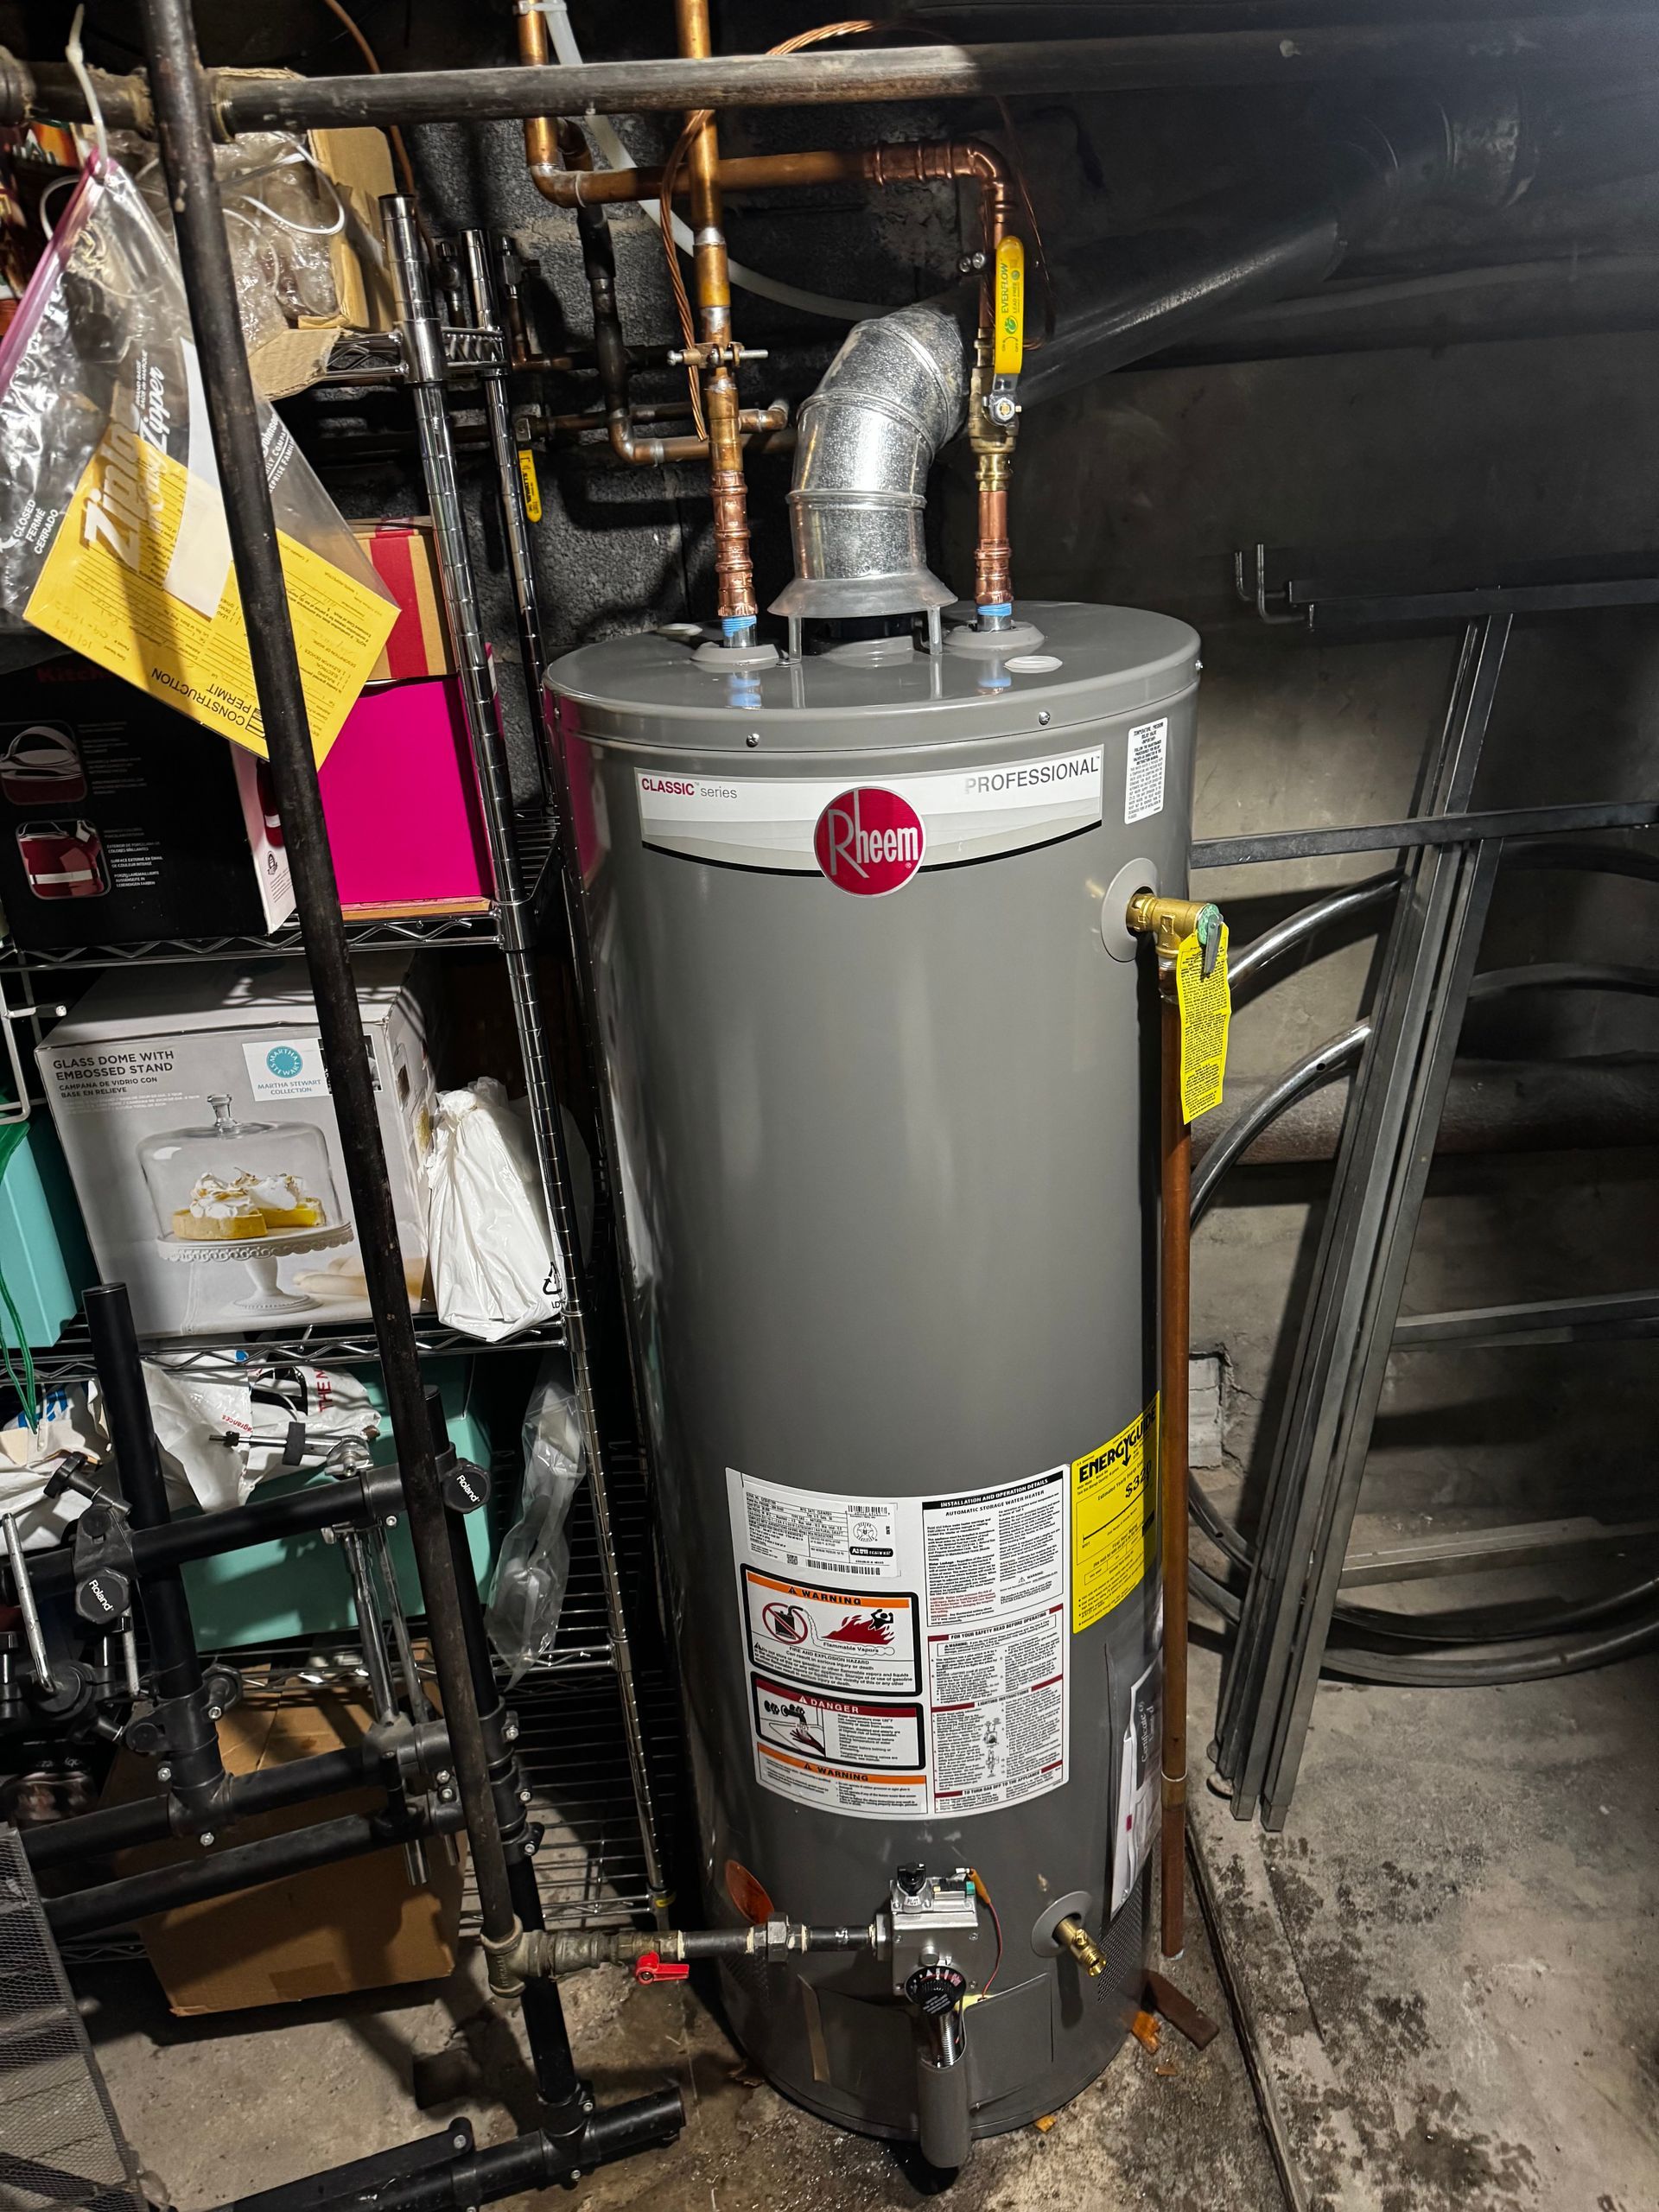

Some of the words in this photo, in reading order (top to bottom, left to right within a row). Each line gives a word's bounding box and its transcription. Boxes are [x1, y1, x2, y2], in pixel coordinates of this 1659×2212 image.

[139, 366, 170, 455] Zipper
[13, 499, 36, 537] CLOSED
[25, 508, 46, 542] FERMÉ
[34, 509, 58, 554] CERRADO
[150, 667, 247, 728] CONSTRUCTION
[205, 682, 253, 714] PERMIT
[965, 758, 1098, 795] PROFESSIONAL
[641, 778, 695, 796] CLASSIC
[700, 786, 738, 799] series
[829, 787, 918, 878] Rheem
[53, 1057, 95, 1069] GLASS
[99, 1054, 137, 1065] DOME
[140, 1051, 174, 1062] WITH
[270, 1049, 298, 1063] MARTHA
[56, 1066, 126, 1081] EMBOSSED
[129, 1062, 173, 1074] STAND
[270, 1062, 300, 1075] STEWART
[58, 1082, 97, 1091] CAMPANA
[111, 1079, 137, 1088] VIDRIO
[61, 1090, 79, 1099] BASE
[95, 1086, 127, 1096] RELIEVE
[271, 1087, 312, 1095] COLLECTION
[317, 1381, 333, 1413] THE
[457, 1475, 479, 1502] Roland
[941, 1497, 981, 1508] INSTALLATION
[995, 1486, 1026, 1499] OPERATION
[1027, 1478, 1048, 1490] DETAILS
[1098, 1485, 1115, 1500] Estimated
[946, 1507, 978, 1516] AUTOMATIC
[980, 1501, 1004, 1512] STORAGE
[1005, 1497, 1024, 1506] WATER
[1025, 1490, 1044, 1500] HEATER
[89, 1579, 113, 1611] Roland
[802, 1589, 862, 1605] WARNING
[975, 1628, 992, 1636] SAFETY
[1006, 1620, 1023, 1629] BEFORE
[1024, 1612, 1047, 1626] OPERATING
[823, 1642, 856, 1652] Flammable
[814, 1652, 846, 1663] EXPLOSION
[811, 1699, 859, 1713] DANGER
[999, 1690, 1029, 1703] INSTRUCTIONS
[817, 1766, 869, 1782] WARNING
[1018, 1772, 1039, 1783] APPLIANCE
